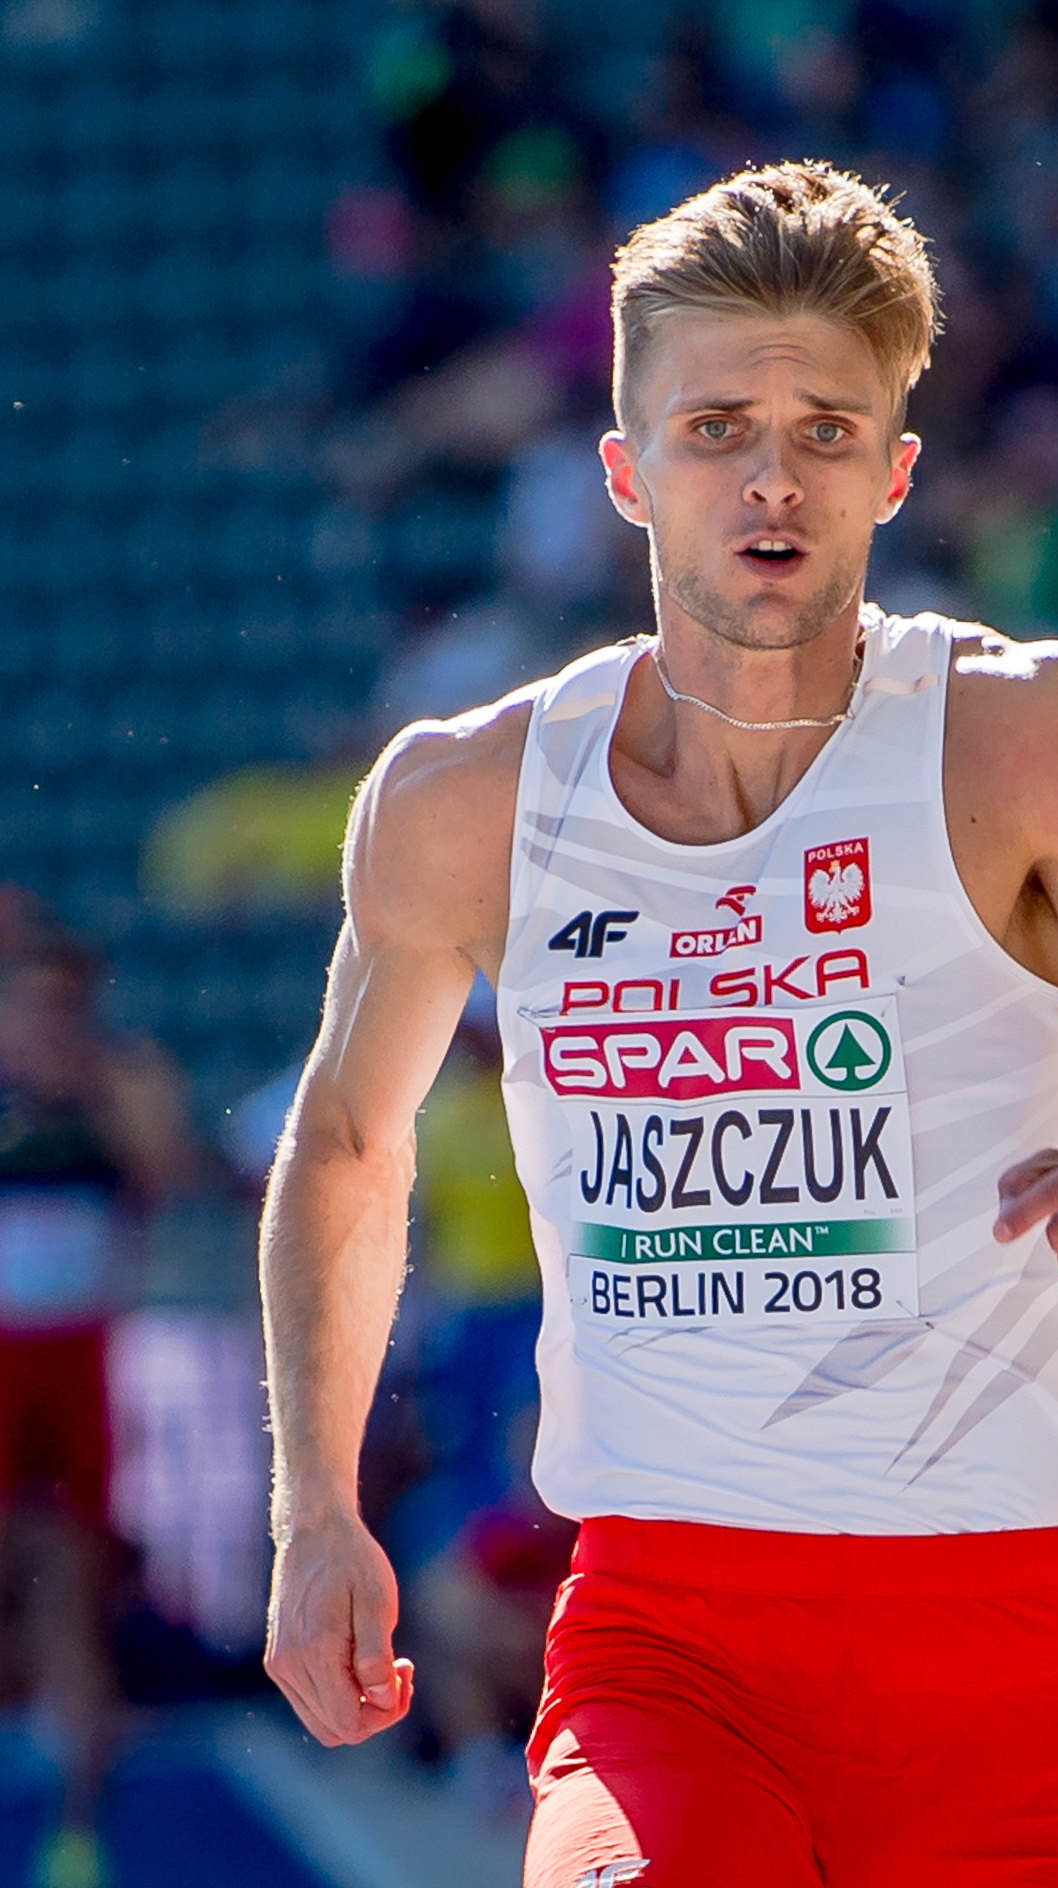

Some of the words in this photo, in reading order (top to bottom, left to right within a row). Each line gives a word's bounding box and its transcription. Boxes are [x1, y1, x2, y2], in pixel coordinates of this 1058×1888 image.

[807, 841, 864, 863] POLSKA
[548, 910, 639, 958] 4F
[549, 1026, 793, 1089] SPAR
[580, 1106, 899, 1213] JASZCZUK
[635, 1231, 702, 1259] RUN
[591, 1270, 744, 1319] BERLIN
[764, 1267, 882, 1313] 2018
